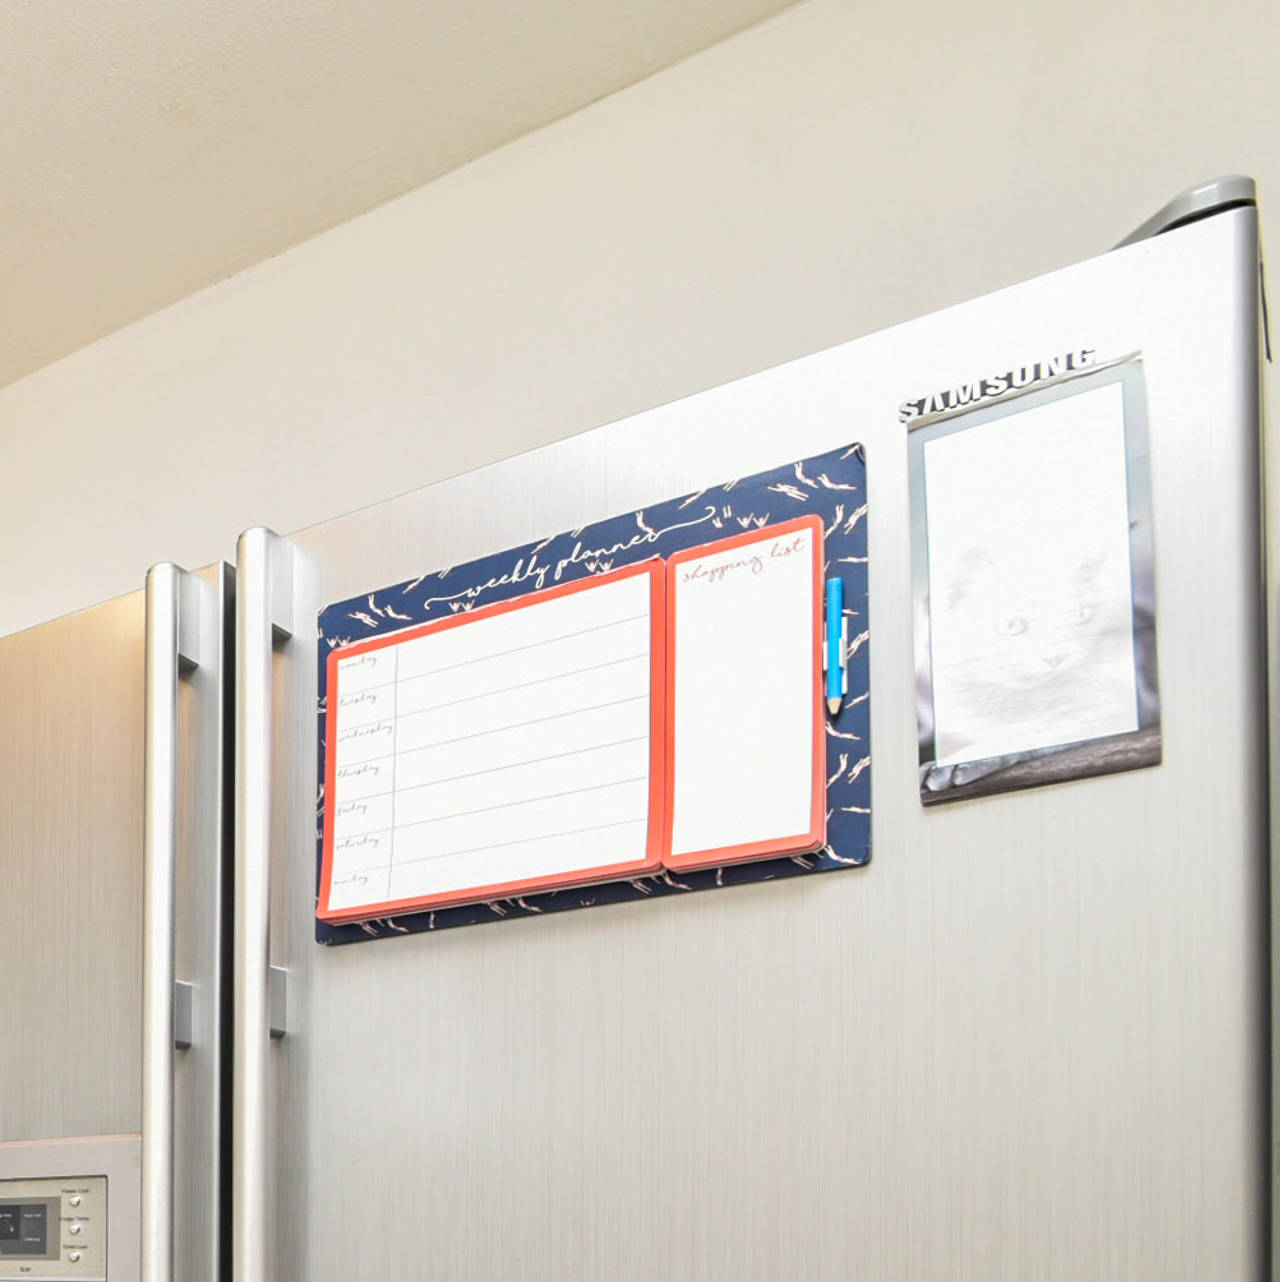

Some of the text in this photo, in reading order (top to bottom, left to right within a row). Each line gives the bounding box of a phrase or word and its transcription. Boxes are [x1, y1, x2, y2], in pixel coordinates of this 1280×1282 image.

[898, 349, 1097, 424] SAMSUNG
[683, 537, 807, 583] shopping list
